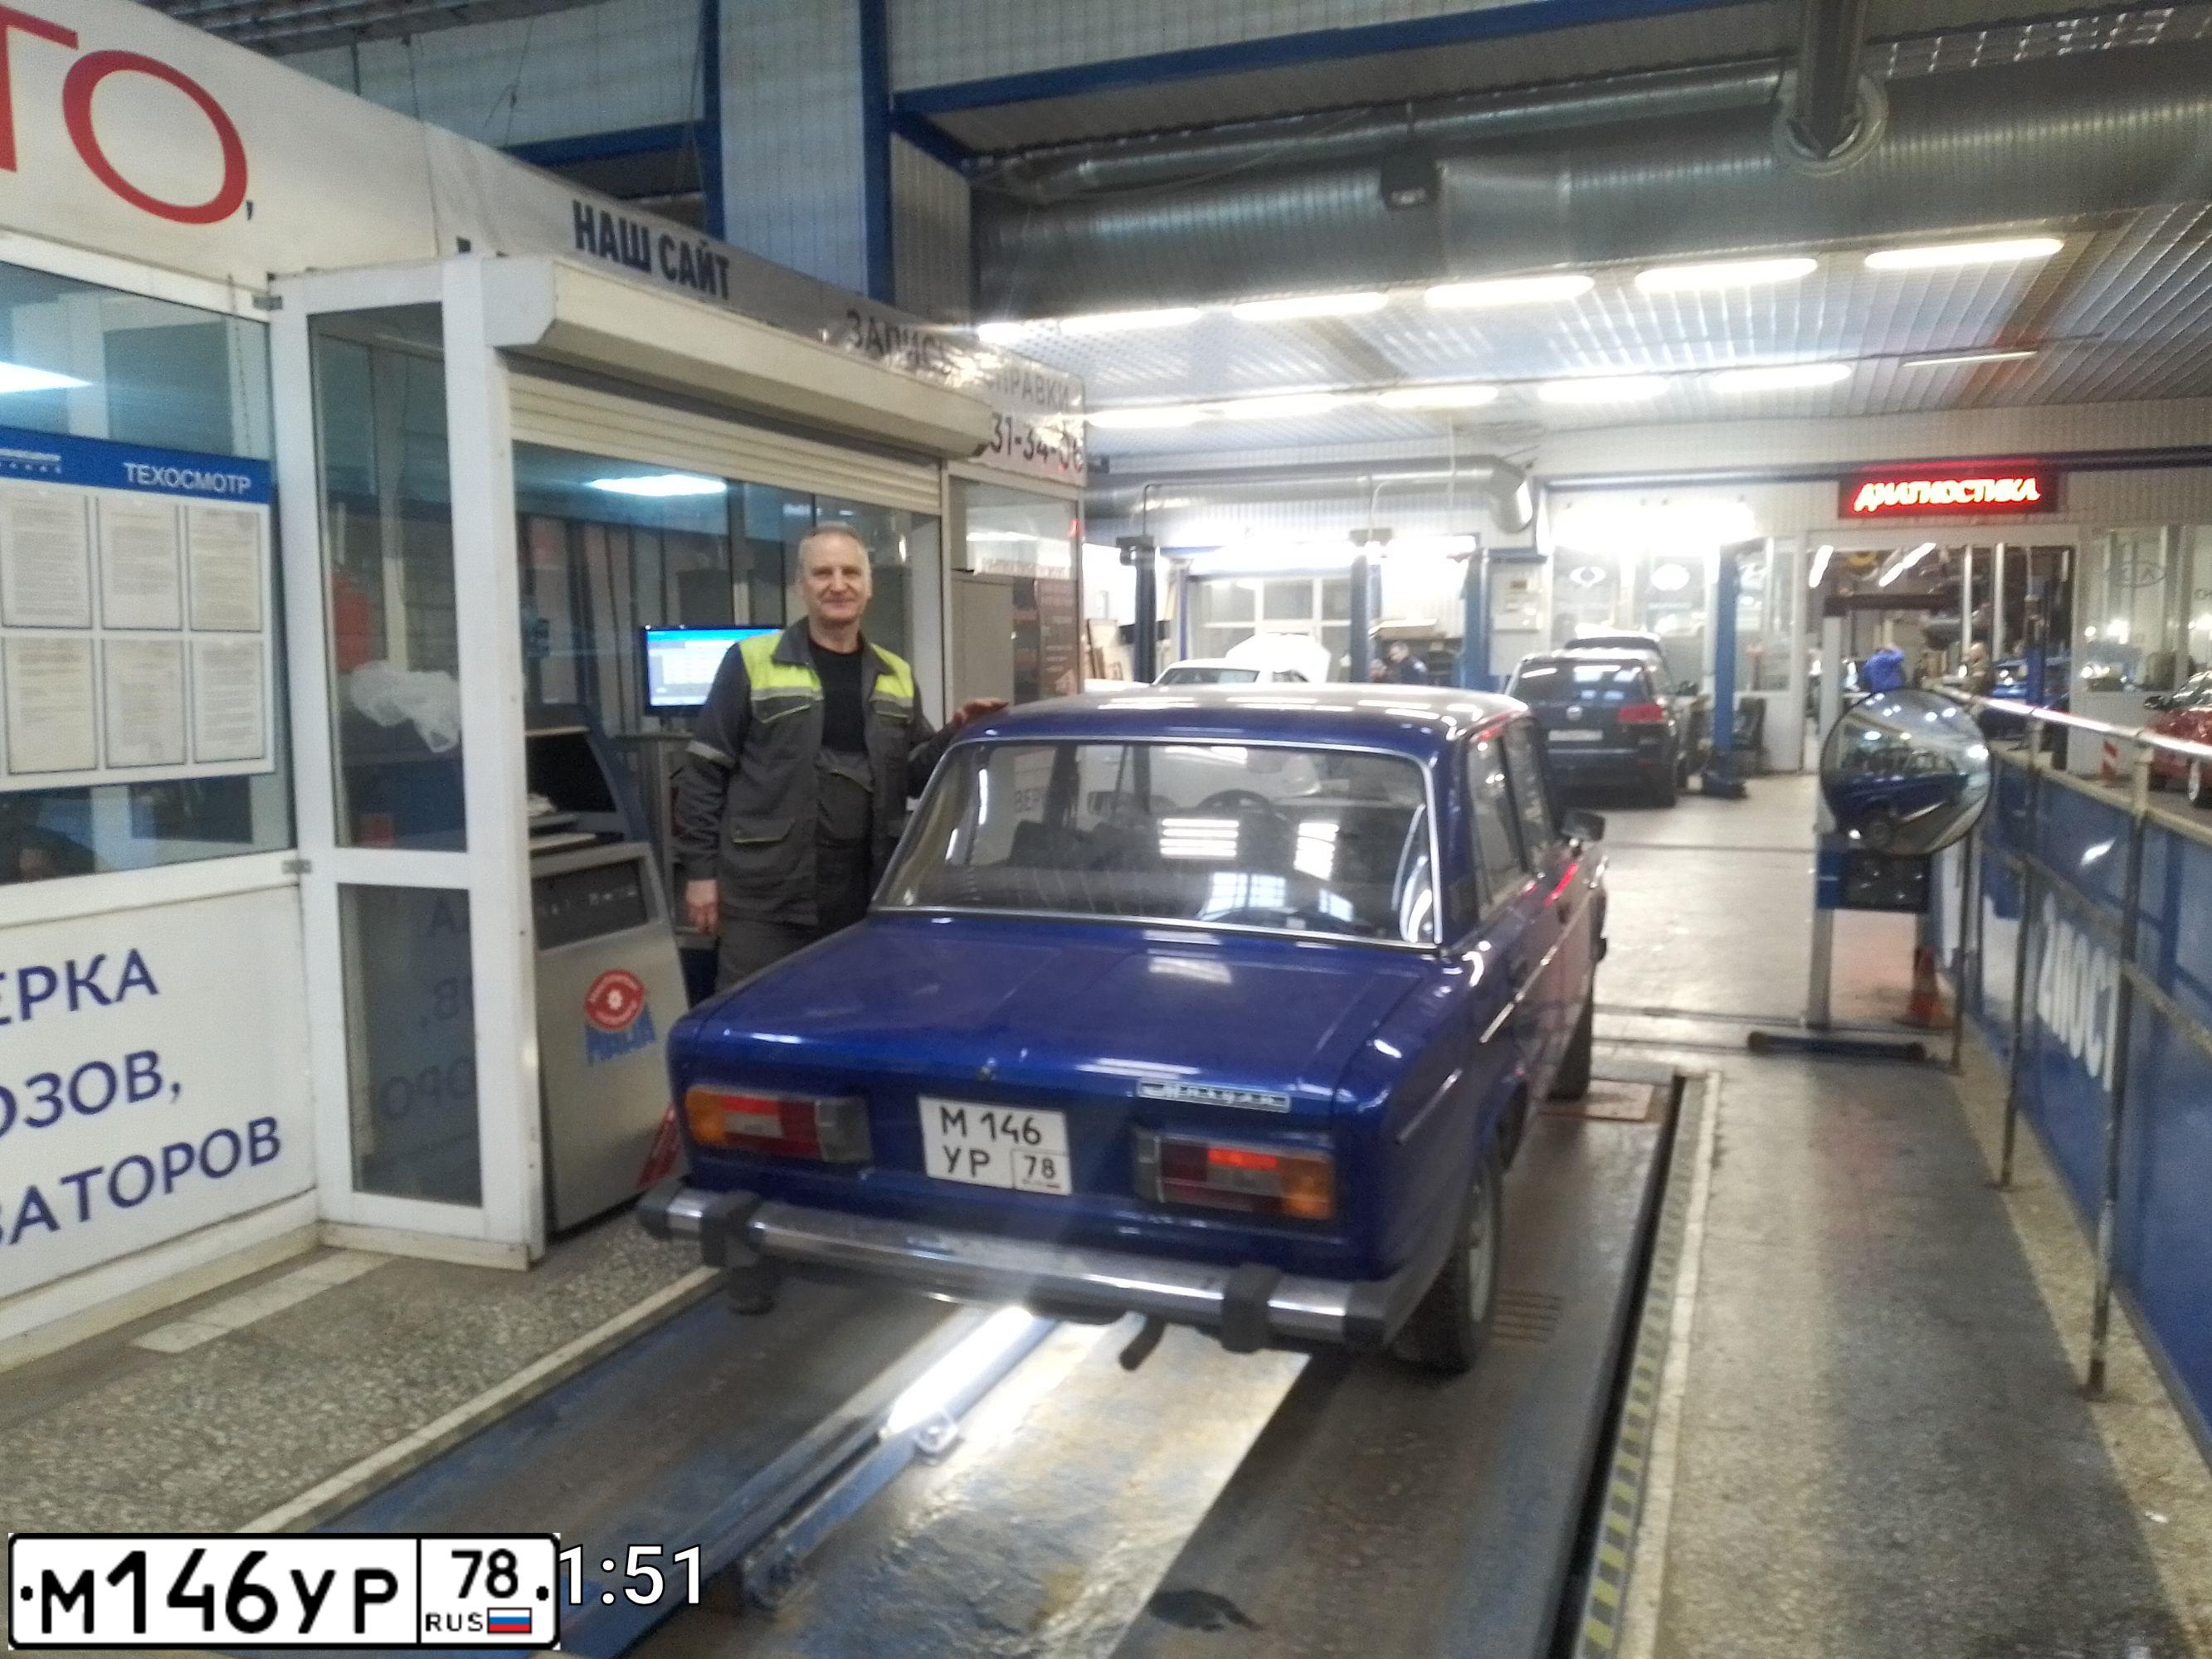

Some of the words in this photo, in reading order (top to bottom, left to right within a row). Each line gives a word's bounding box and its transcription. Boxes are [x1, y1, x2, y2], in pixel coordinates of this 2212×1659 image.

[572, 199, 651, 273] НАШ
[659, 233, 729, 300] САЙТ
[846, 308, 950, 374] ЗАПИС
[123, 462, 251, 494] ТЕХОСМОТР
[1853, 478, 2041, 513] ДИАГНОСТИКА
[0, 1116, 281, 1245] АТОРОВ
[1023, 1155, 1056, 1180] 78
